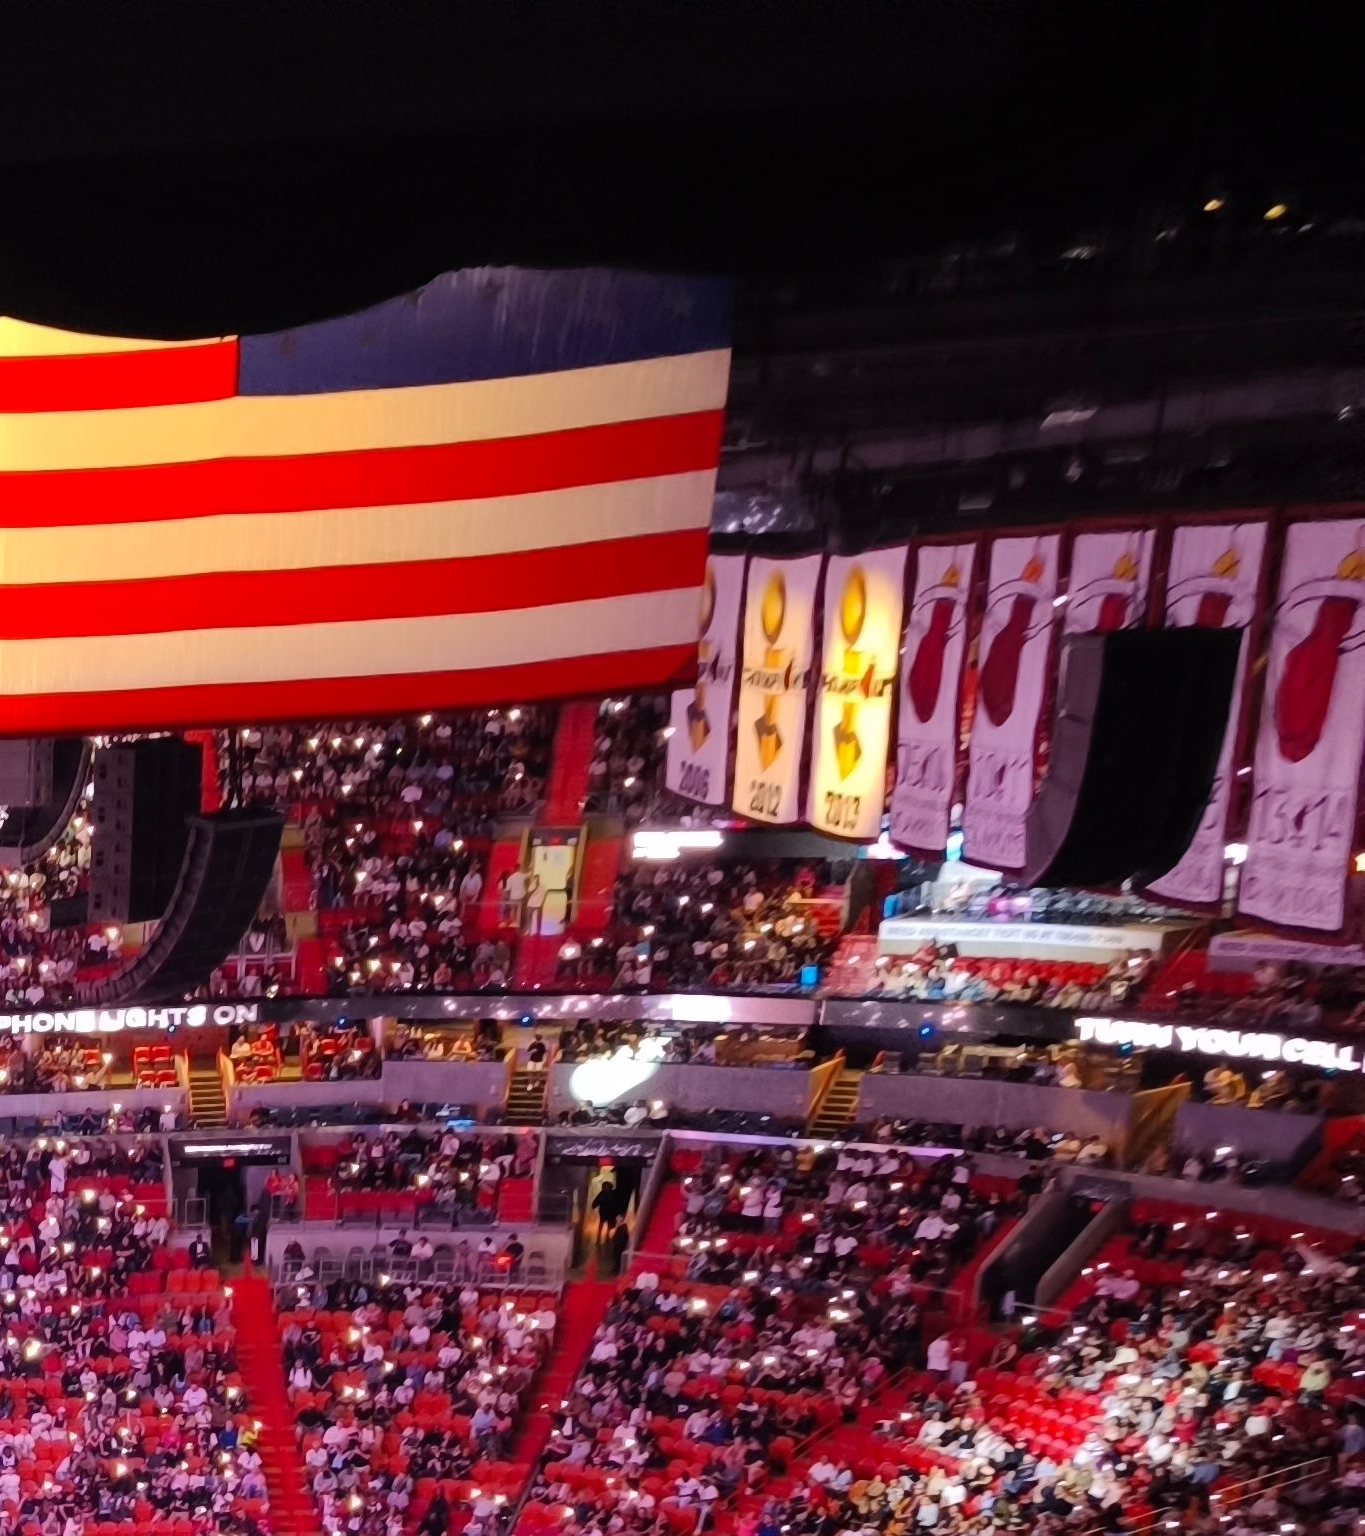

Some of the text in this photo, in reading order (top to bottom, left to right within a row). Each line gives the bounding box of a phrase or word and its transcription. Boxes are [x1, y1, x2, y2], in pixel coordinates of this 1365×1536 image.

[98, 1004, 207, 1032] LIGHTS
[212, 1003, 260, 1025] ON
[1073, 1017, 1362, 1072] TURN YOUR CELL
